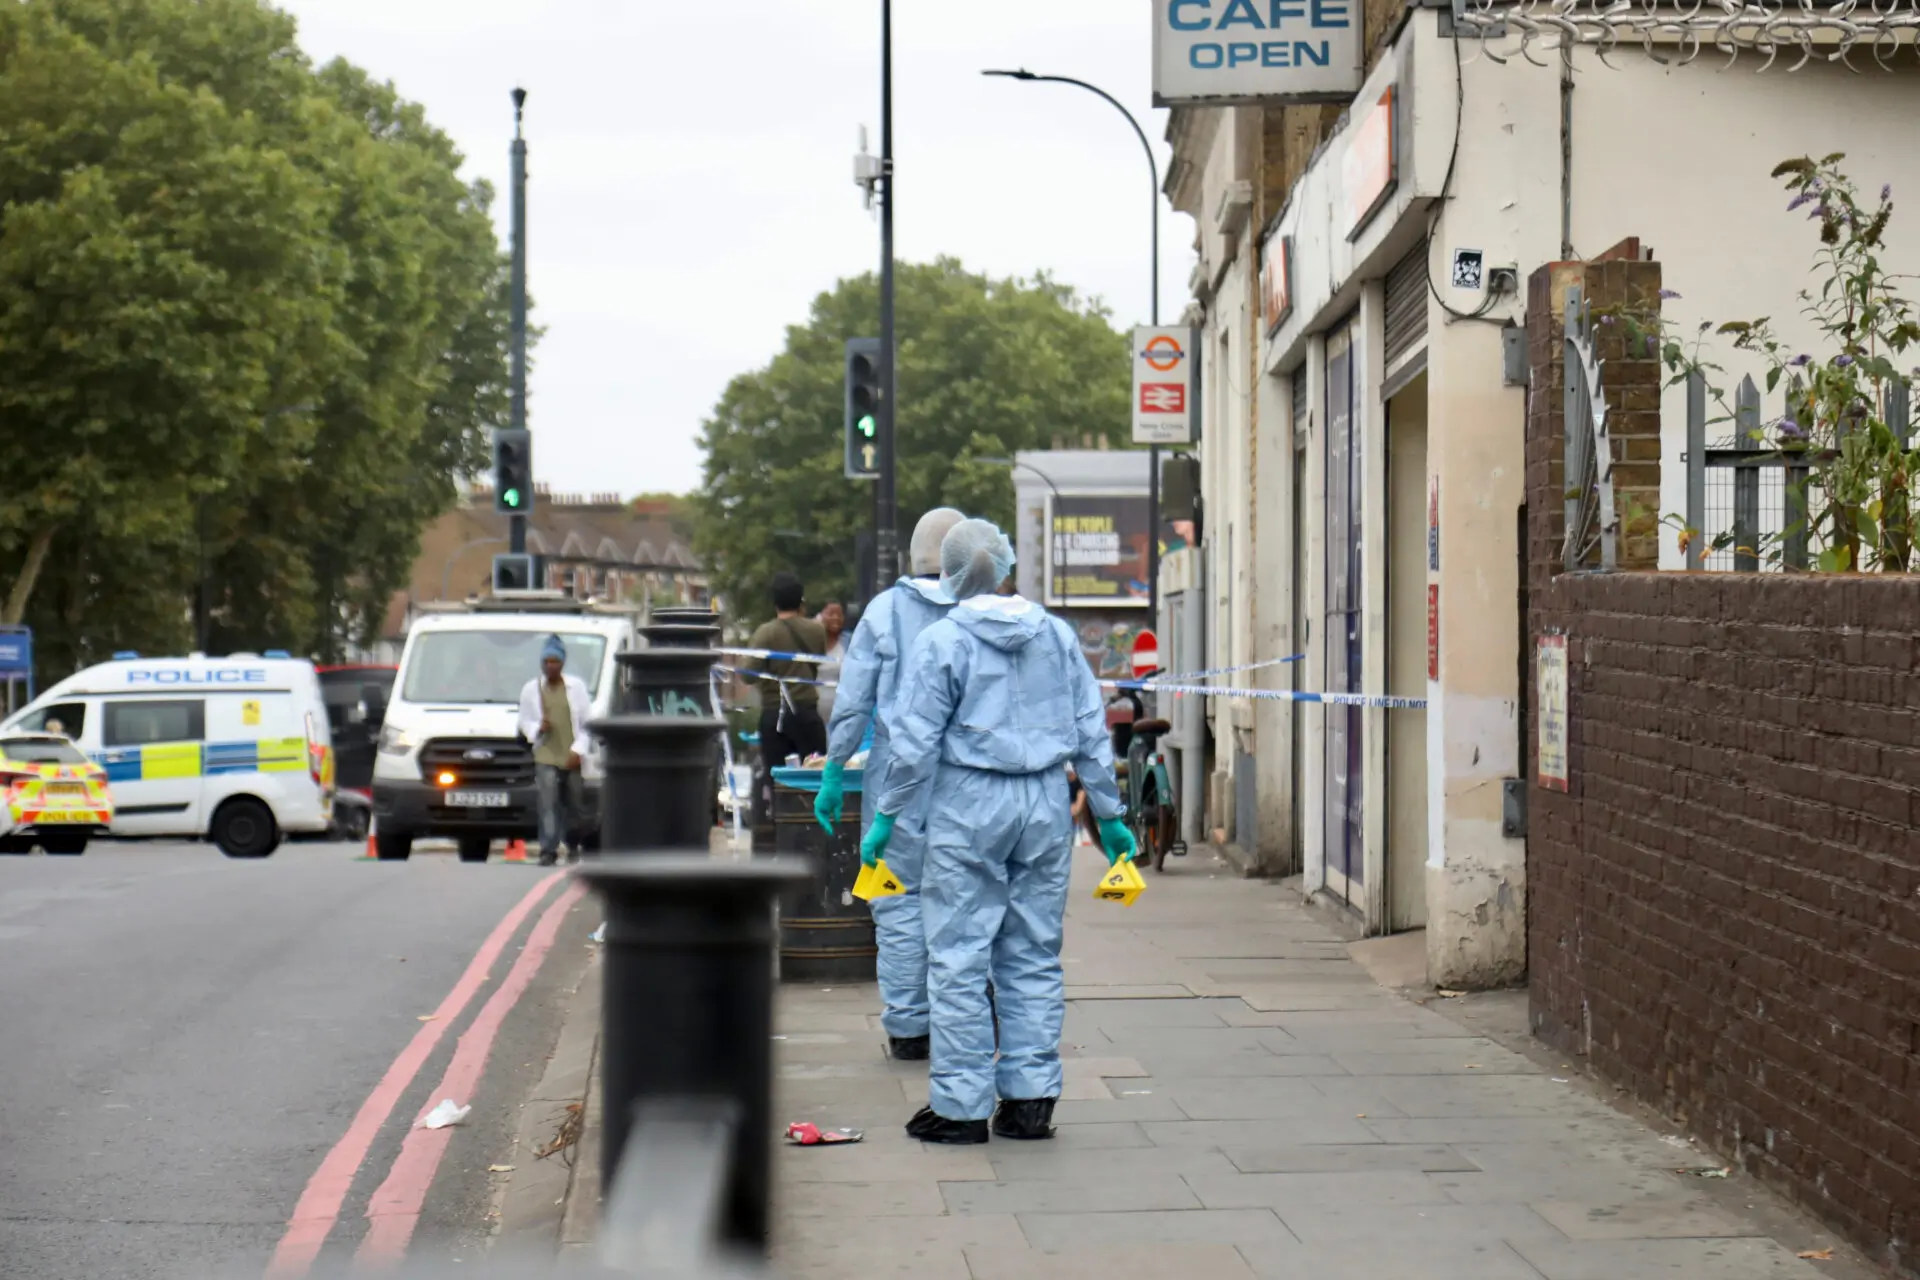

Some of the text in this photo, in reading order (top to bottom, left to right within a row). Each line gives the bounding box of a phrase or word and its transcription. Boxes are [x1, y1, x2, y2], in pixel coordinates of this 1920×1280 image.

[1168, 0, 1349, 31] CAFE
[1189, 41, 1329, 69] OPEN
[127, 670, 266, 683] POLICE
